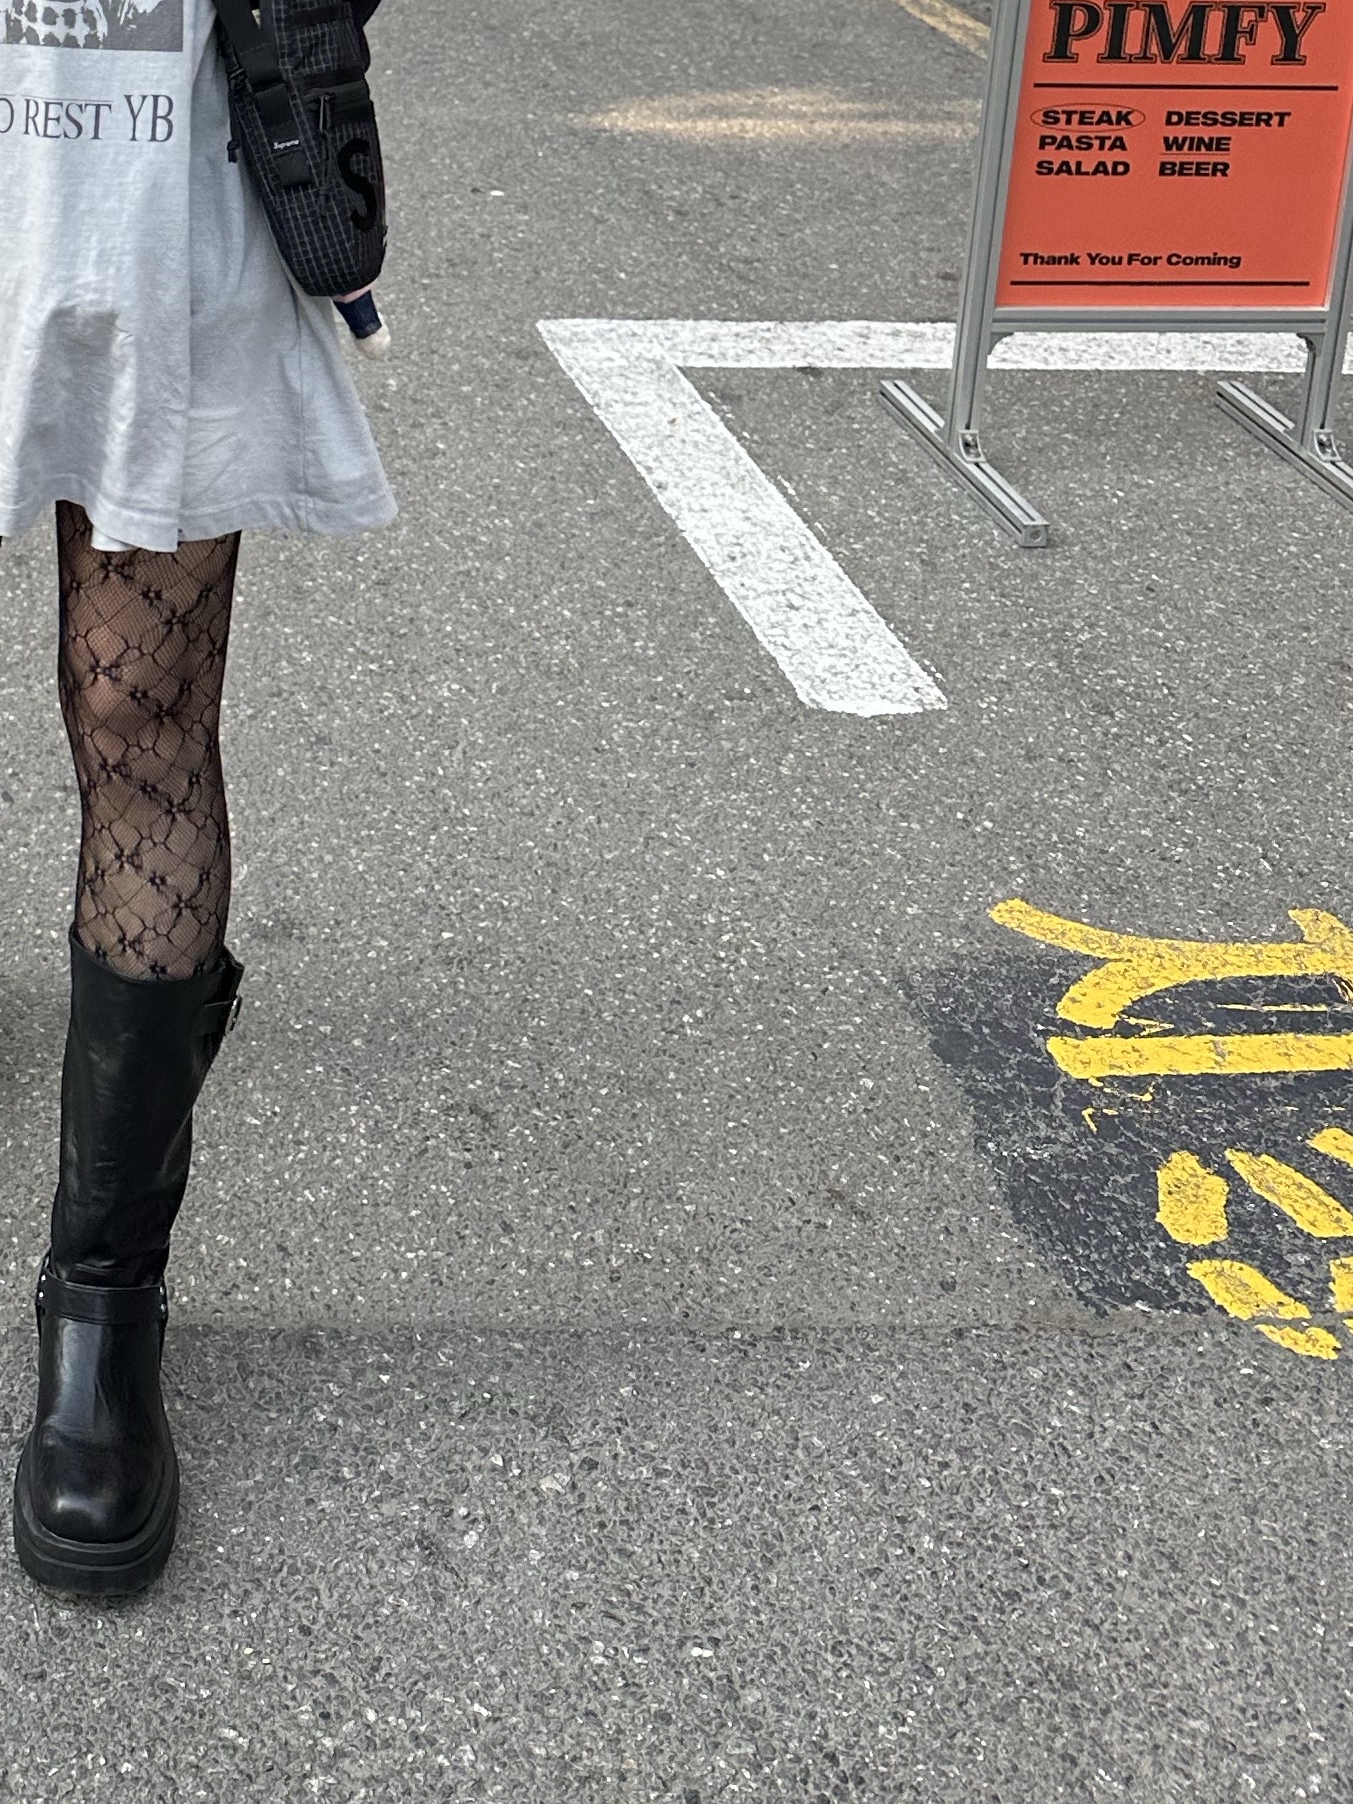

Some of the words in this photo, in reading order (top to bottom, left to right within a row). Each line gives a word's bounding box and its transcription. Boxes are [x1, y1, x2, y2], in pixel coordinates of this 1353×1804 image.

[1042, 0, 1326, 66] PIMFY
[23, 98, 112, 140] REST
[124, 94, 175, 143] YB
[1041, 110, 1135, 127] STEAK
[1164, 110, 1292, 128] DESSERT
[1038, 135, 1128, 152] PASTA
[1162, 136, 1232, 153] WINE
[1035, 160, 1131, 177] SALAD
[1158, 161, 1231, 178] BEER
[1019, 252, 1081, 267] Thank
[1086, 252, 1124, 267] You
[1126, 253, 1163, 267] For
[1166, 252, 1242, 269] Coming
